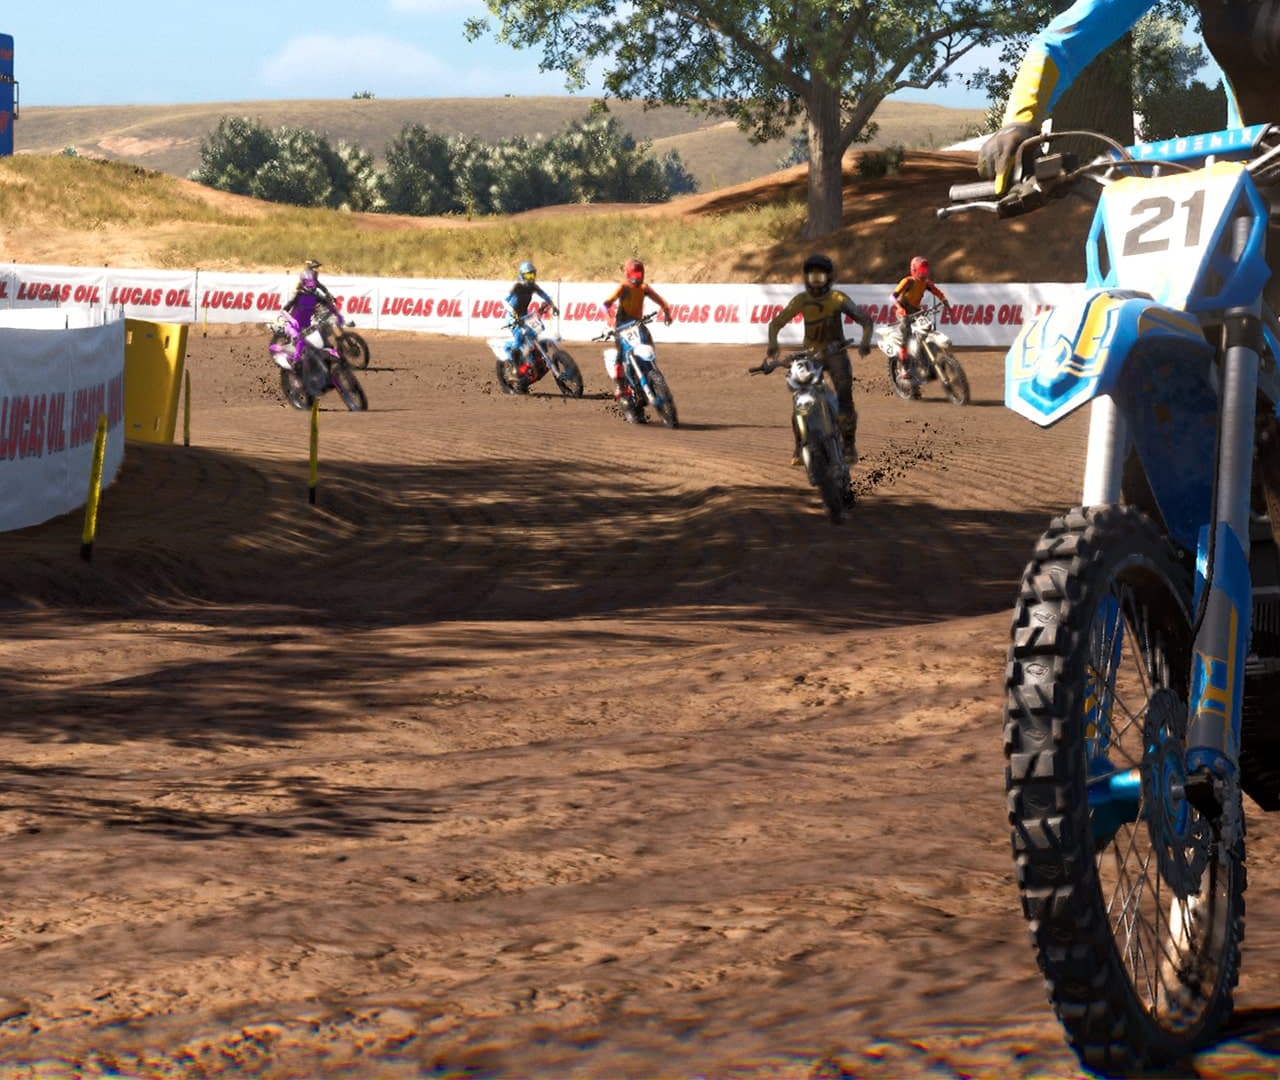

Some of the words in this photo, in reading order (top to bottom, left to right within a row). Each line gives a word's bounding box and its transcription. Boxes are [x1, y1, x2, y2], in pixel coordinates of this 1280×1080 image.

[1122, 189, 1206, 257] 21
[17, 282, 71, 302] LUCAS
[74, 285, 100, 303] OIL
[109, 287, 163, 306] LUCAS
[165, 289, 191, 307] OIL
[201, 290, 253, 310] LUCAS
[256, 292, 282, 311] OIL
[346, 296, 372, 314] OIL
[380, 297, 433, 317] LUCAS
[436, 299, 462, 317] OIL
[714, 304, 739, 324] OIL
[941, 304, 994, 325] LUCAS
[997, 304, 1024, 325] OIL
